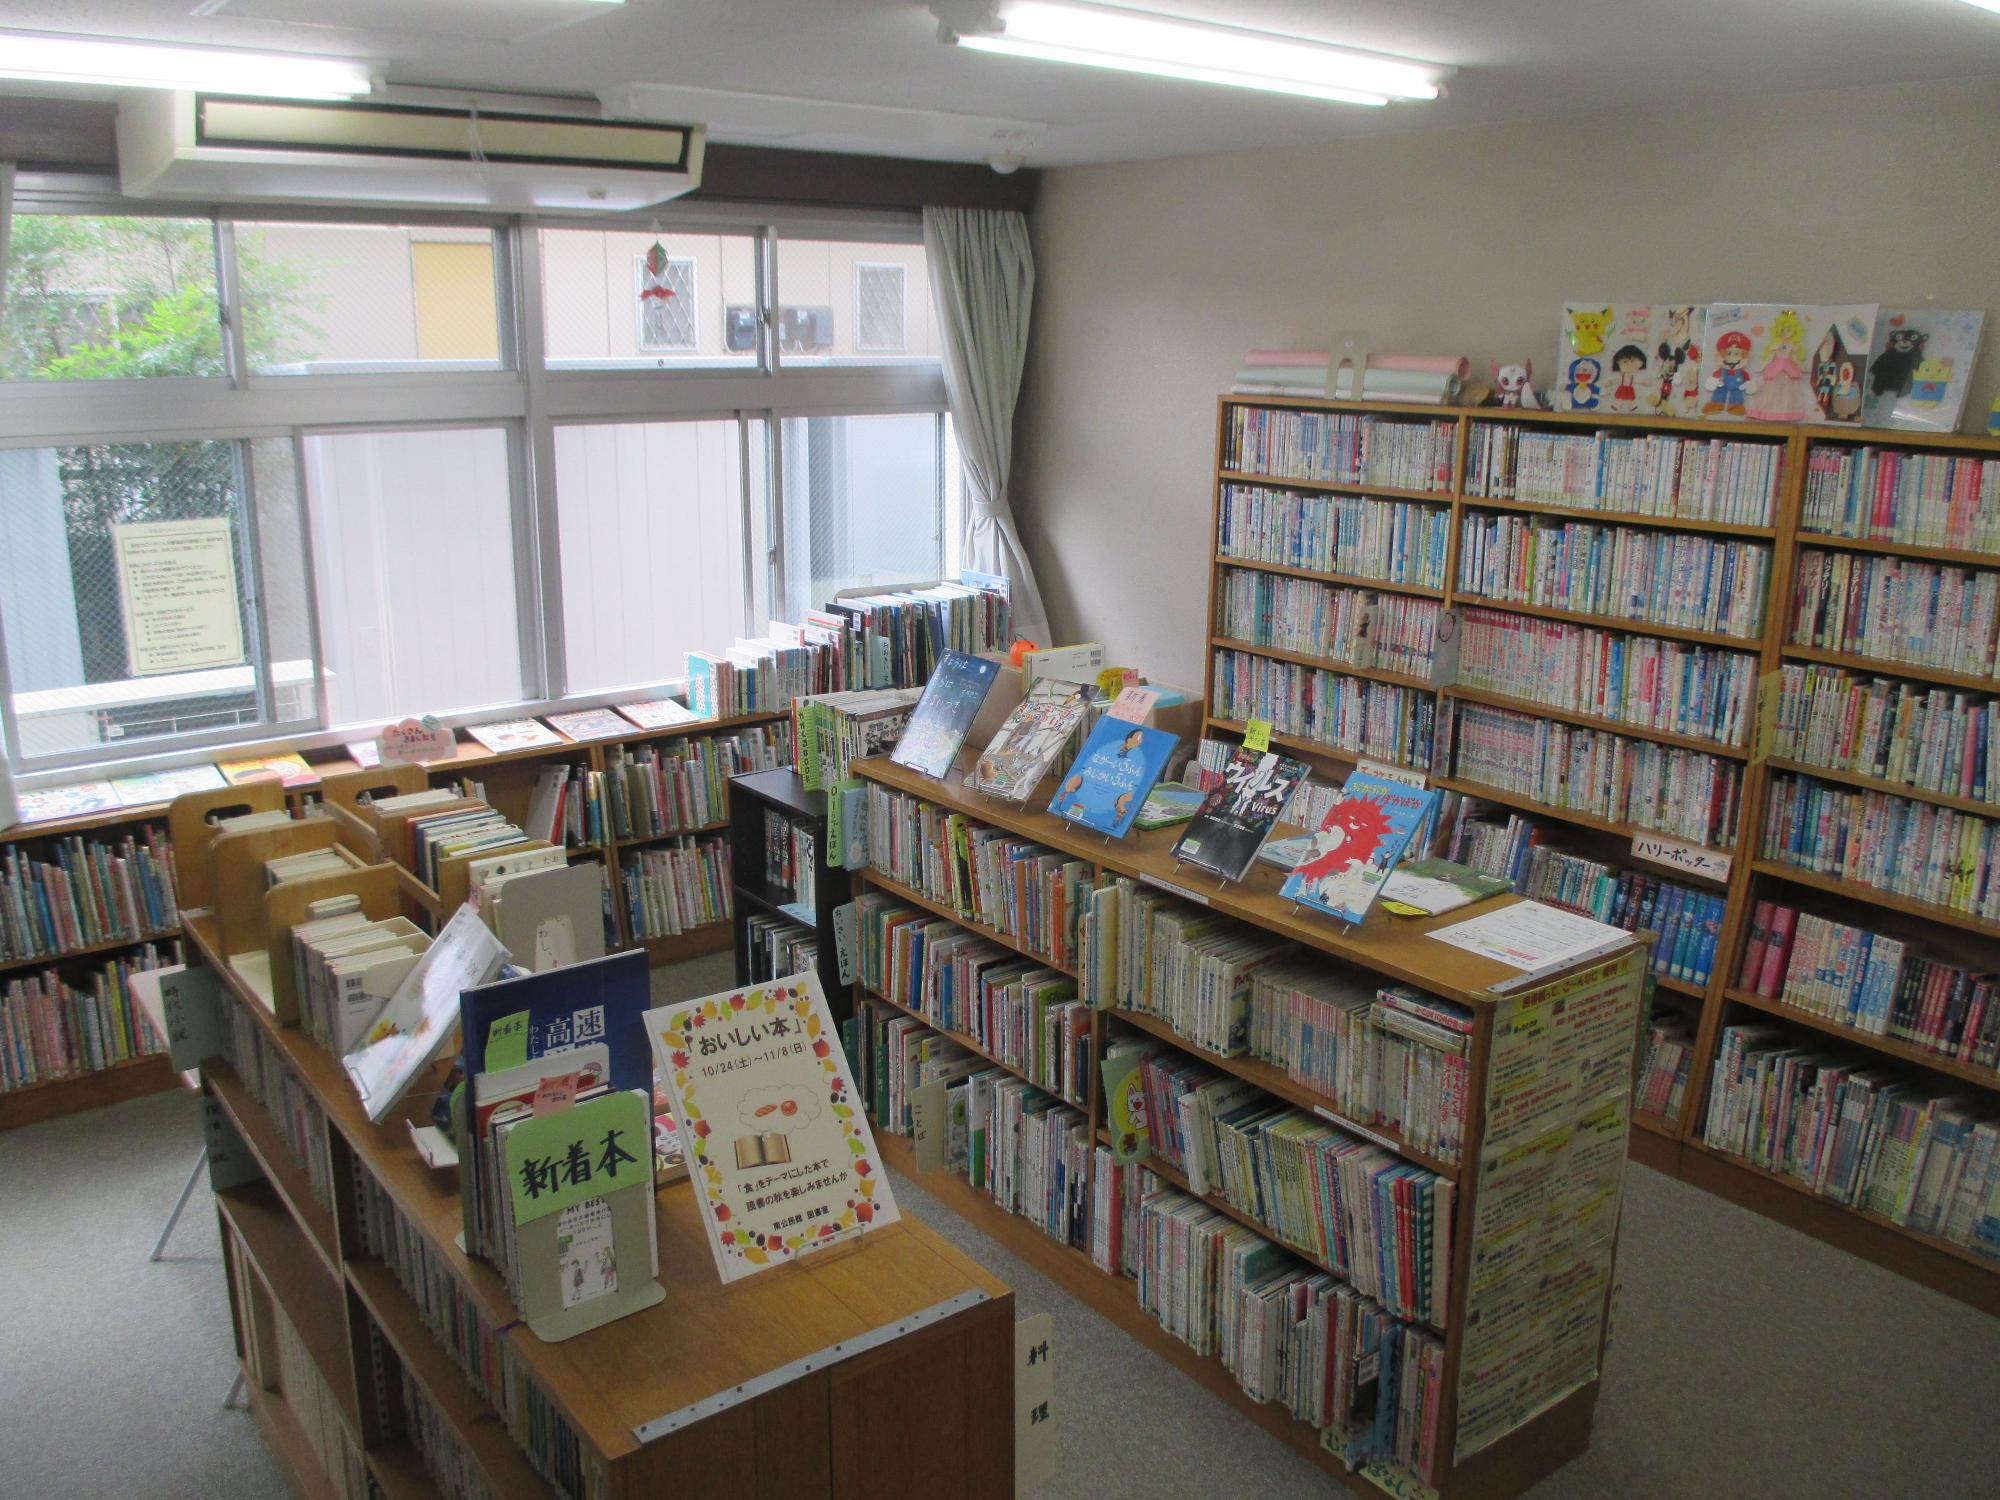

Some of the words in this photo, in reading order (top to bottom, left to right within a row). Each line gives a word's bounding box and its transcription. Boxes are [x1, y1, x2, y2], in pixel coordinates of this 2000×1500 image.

[1250, 800, 1280, 816] Virus
[1637, 841, 1712, 869] ハリーポッター
[545, 1008, 603, 1048] 高速
[913, 1103, 928, 1143] ことば
[518, 1129, 640, 1200] 新着本
[736, 1158, 830, 1194] 「食」をテーマにした本で
[745, 1171, 849, 1213] 読書の秋を楽しみませんか
[1027, 1339, 1049, 1426] 料理
